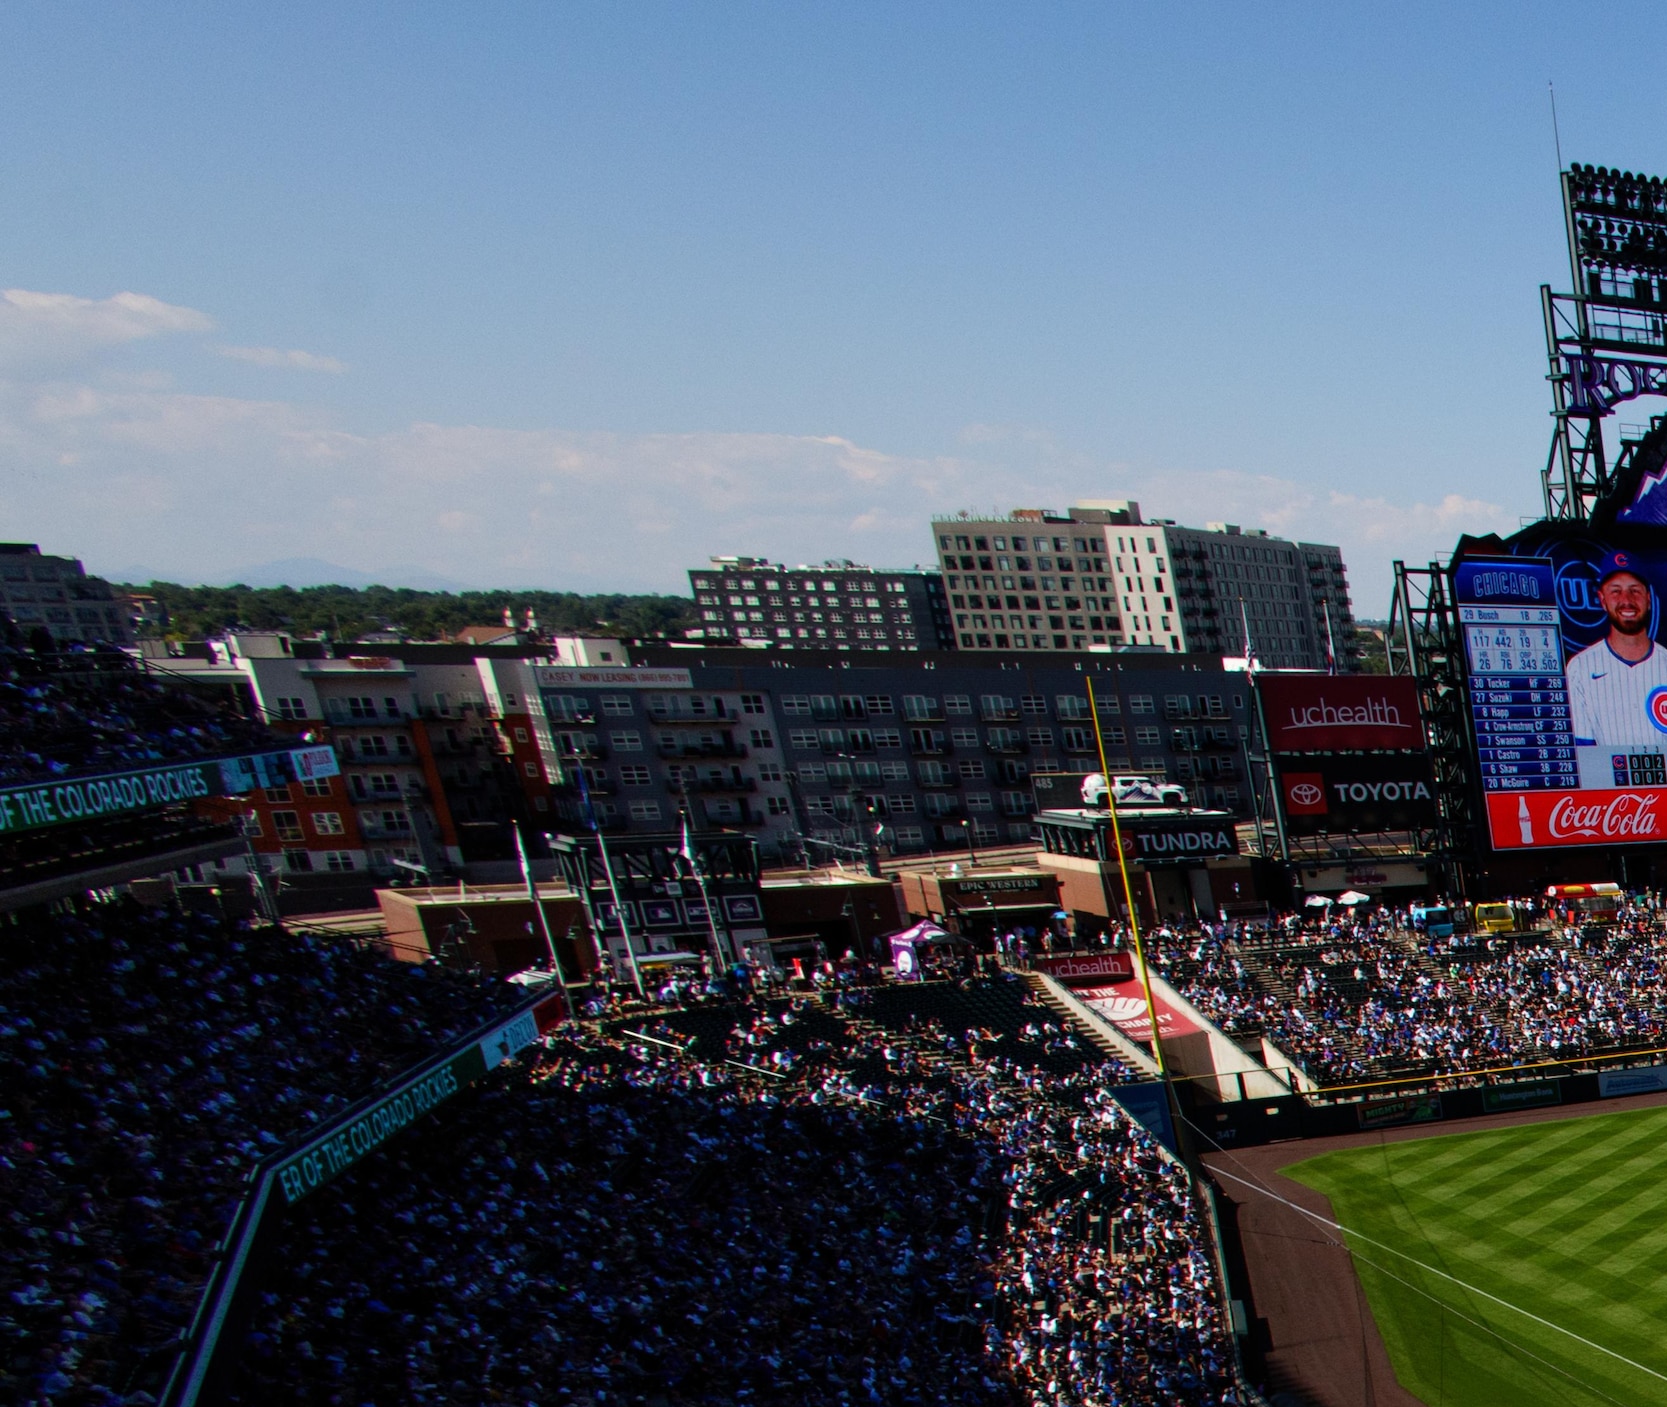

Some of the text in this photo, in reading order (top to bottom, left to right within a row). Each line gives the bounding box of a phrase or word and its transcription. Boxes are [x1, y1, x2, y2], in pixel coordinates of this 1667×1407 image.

[1473, 572, 1539, 599] CHICAGO
[1464, 610, 1552, 621] 29 Busch 1B .265
[1474, 636, 1530, 648] 117 442 19
[1480, 660, 1558, 670] 26 76 .343 .502
[1487, 679, 1510, 688] Tucker
[1489, 693, 1512, 702] Suzuki
[1291, 697, 1399, 726] uchealth
[1491, 707, 1509, 719] Happ
[1496, 736, 1525, 745] Swanson
[1497, 750, 1520, 759] Castro
[1499, 764, 1518, 773] Shaw
[1502, 778, 1529, 787] McGuire
[15, 768, 208, 824] THE COLORADO ROCKIES
[1334, 782, 1431, 802] TOYOTA
[1549, 794, 1660, 838] Coca-Cola
[1138, 832, 1231, 851] TUNDRA
[960, 879, 1038, 891] EPIC WESTERN
[1048, 957, 1121, 977] uchealth
[1092, 987, 1120, 997] THE
[303, 1151, 322, 1186] OF
[322, 1134, 352, 1172] THE
[350, 1094, 414, 1154] COLORADO
[412, 1066, 458, 1114] ROCKIES
